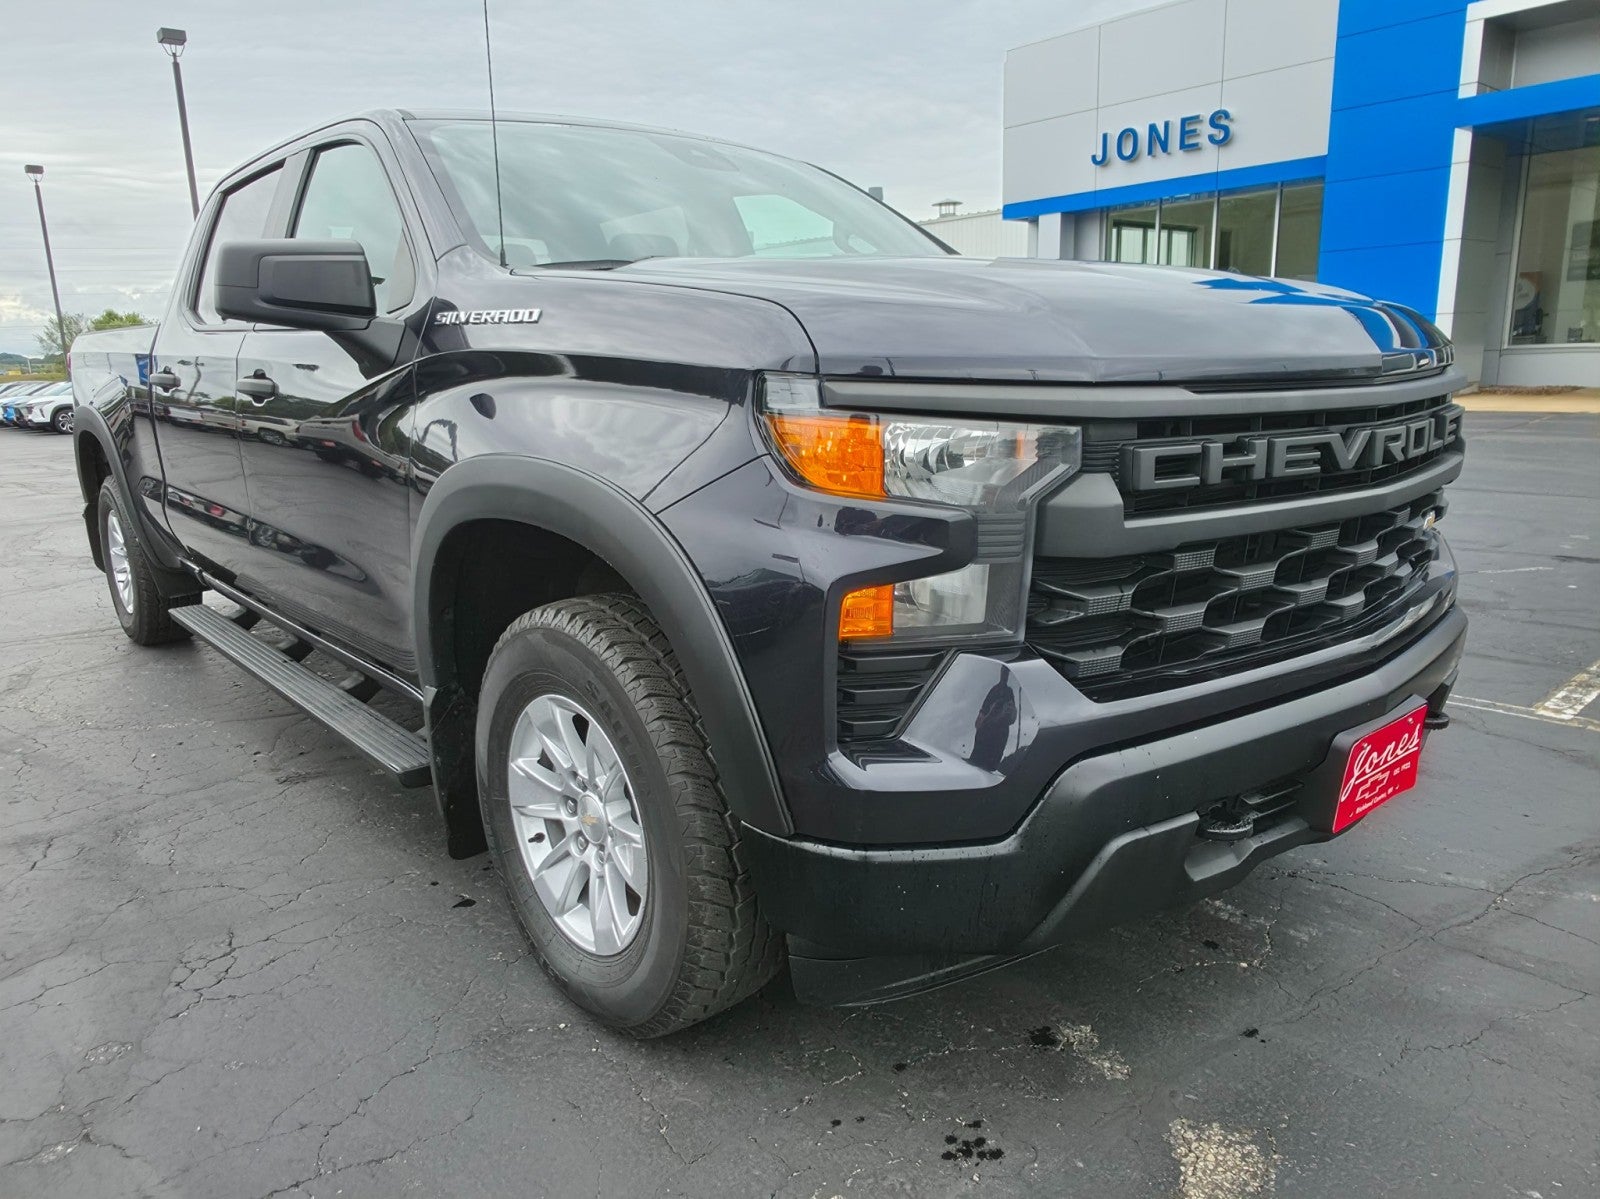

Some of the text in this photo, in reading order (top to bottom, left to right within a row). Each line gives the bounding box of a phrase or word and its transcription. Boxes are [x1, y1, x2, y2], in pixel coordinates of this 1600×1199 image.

[1091, 108, 1233, 166] JONES
[434, 308, 541, 325] SILVERADO
[1131, 407, 1465, 490] CHEVROLE
[1341, 723, 1421, 802] Jones
